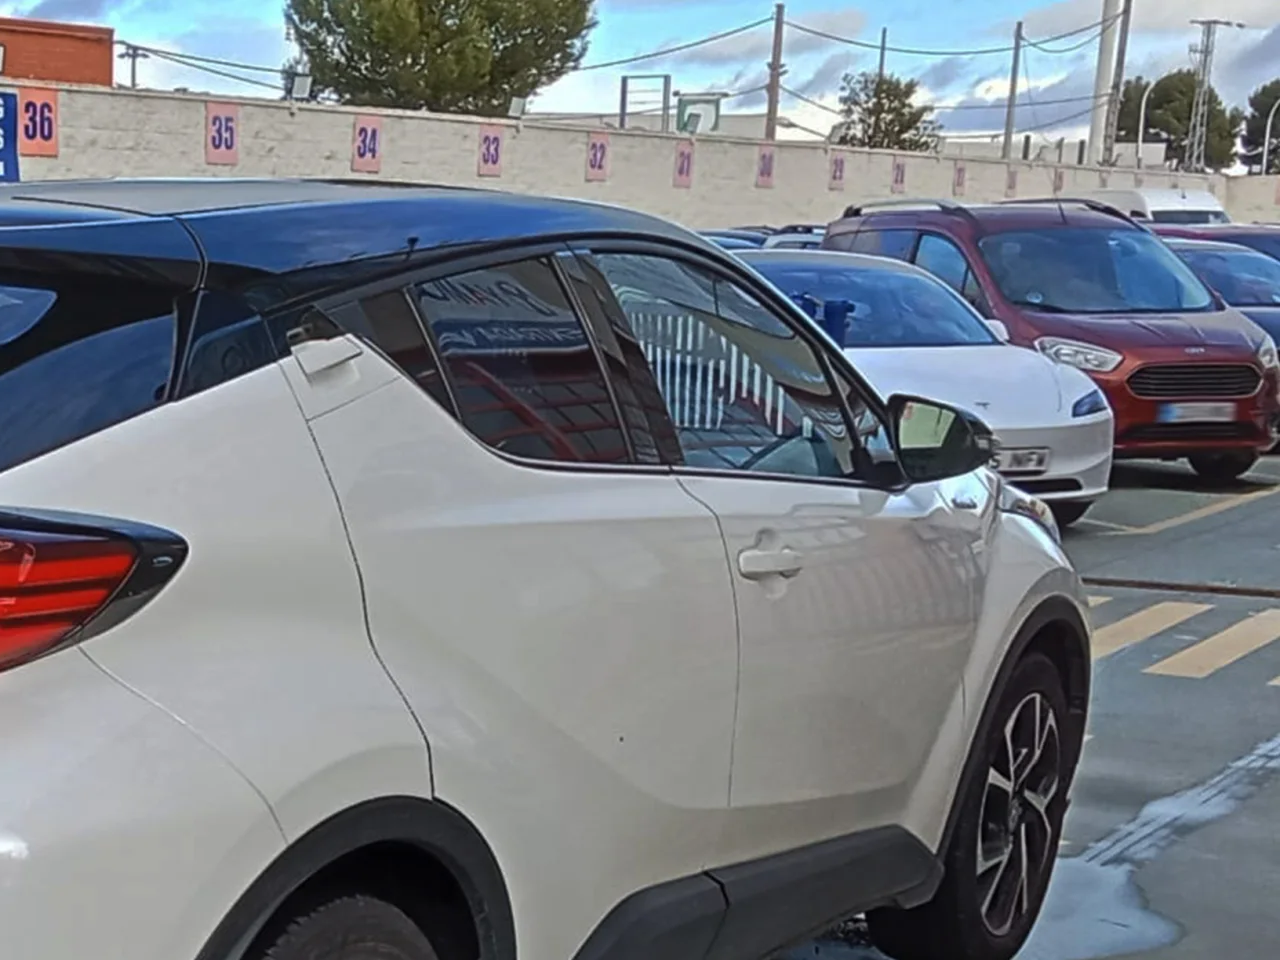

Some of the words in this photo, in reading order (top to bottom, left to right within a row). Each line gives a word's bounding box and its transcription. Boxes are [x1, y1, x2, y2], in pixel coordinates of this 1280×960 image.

[24, 101, 54, 142] 36
[211, 115, 235, 151] 35
[356, 127, 378, 159] 34
[482, 135, 500, 165] 33
[589, 143, 607, 170] 32
